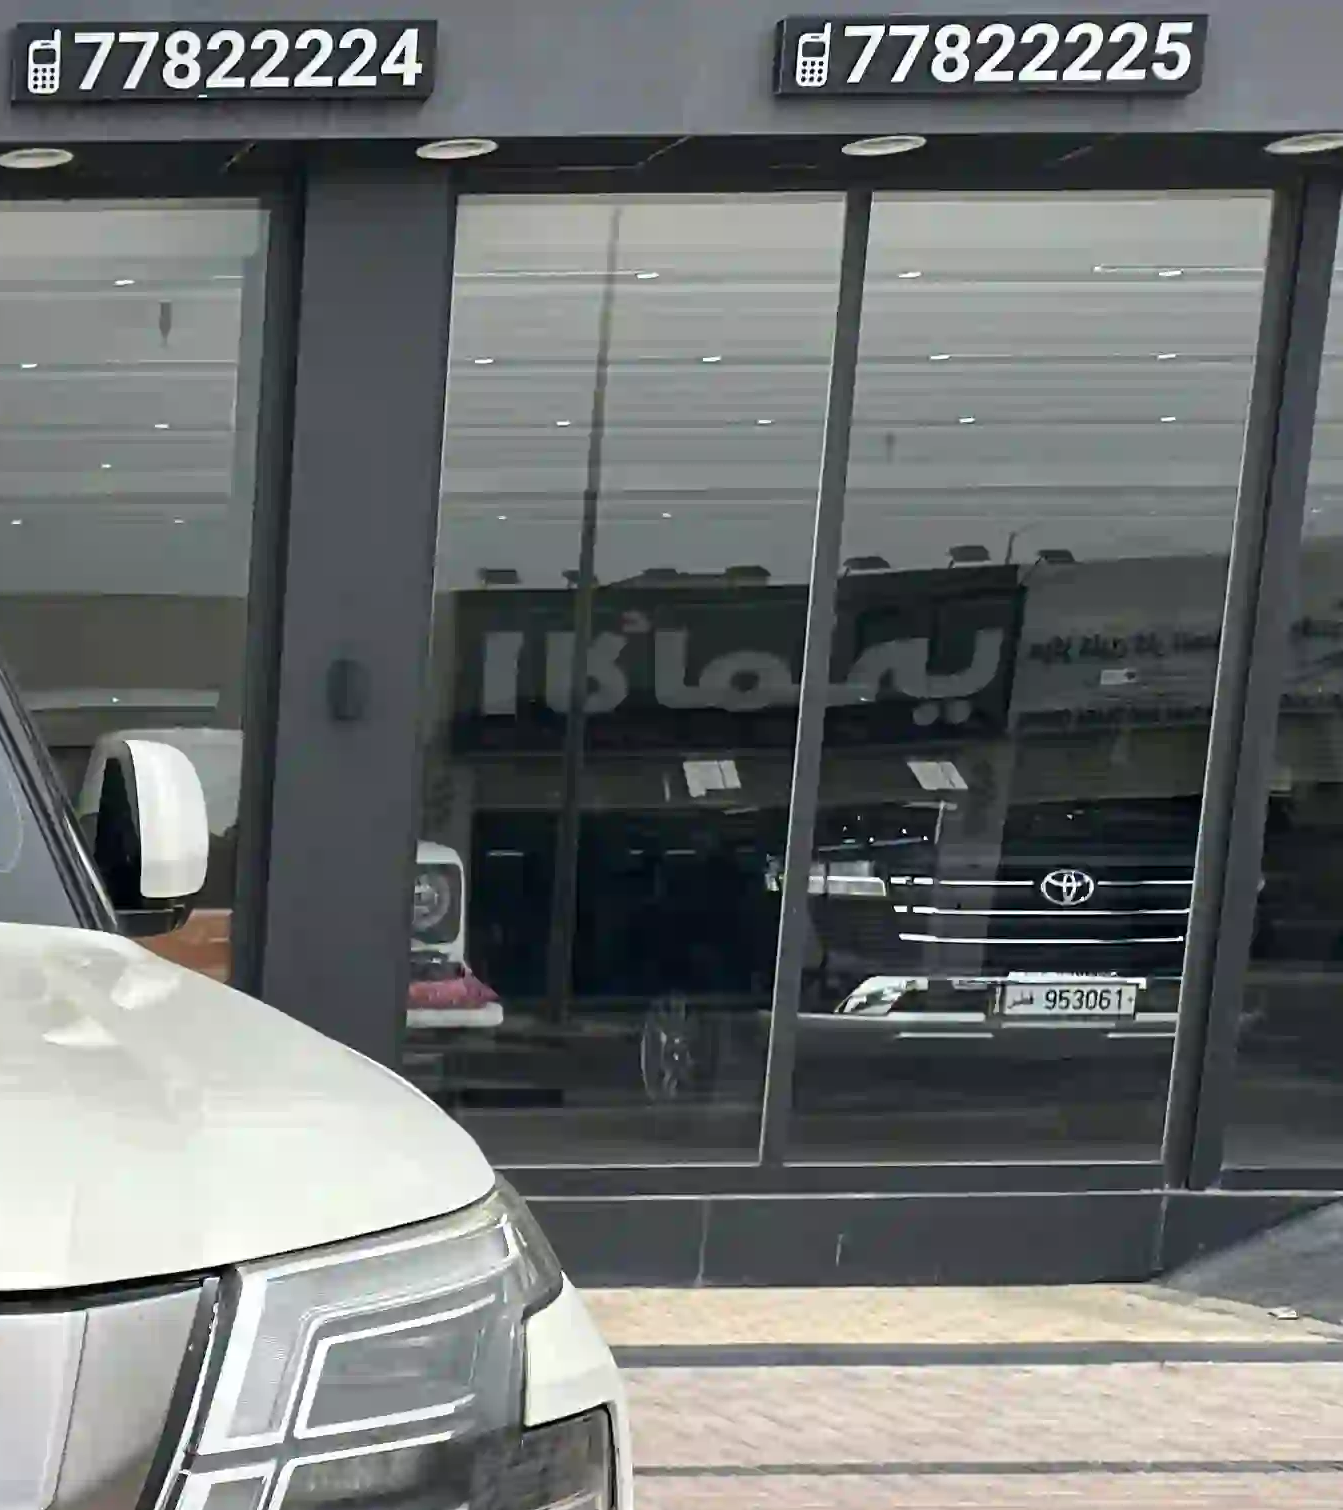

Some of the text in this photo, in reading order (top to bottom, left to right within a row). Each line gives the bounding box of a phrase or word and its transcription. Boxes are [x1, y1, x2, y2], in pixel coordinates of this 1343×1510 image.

[74, 28, 423, 90] 77822224
[844, 21, 1193, 84] 77822225
[1044, 988, 1123, 1011] 953061
